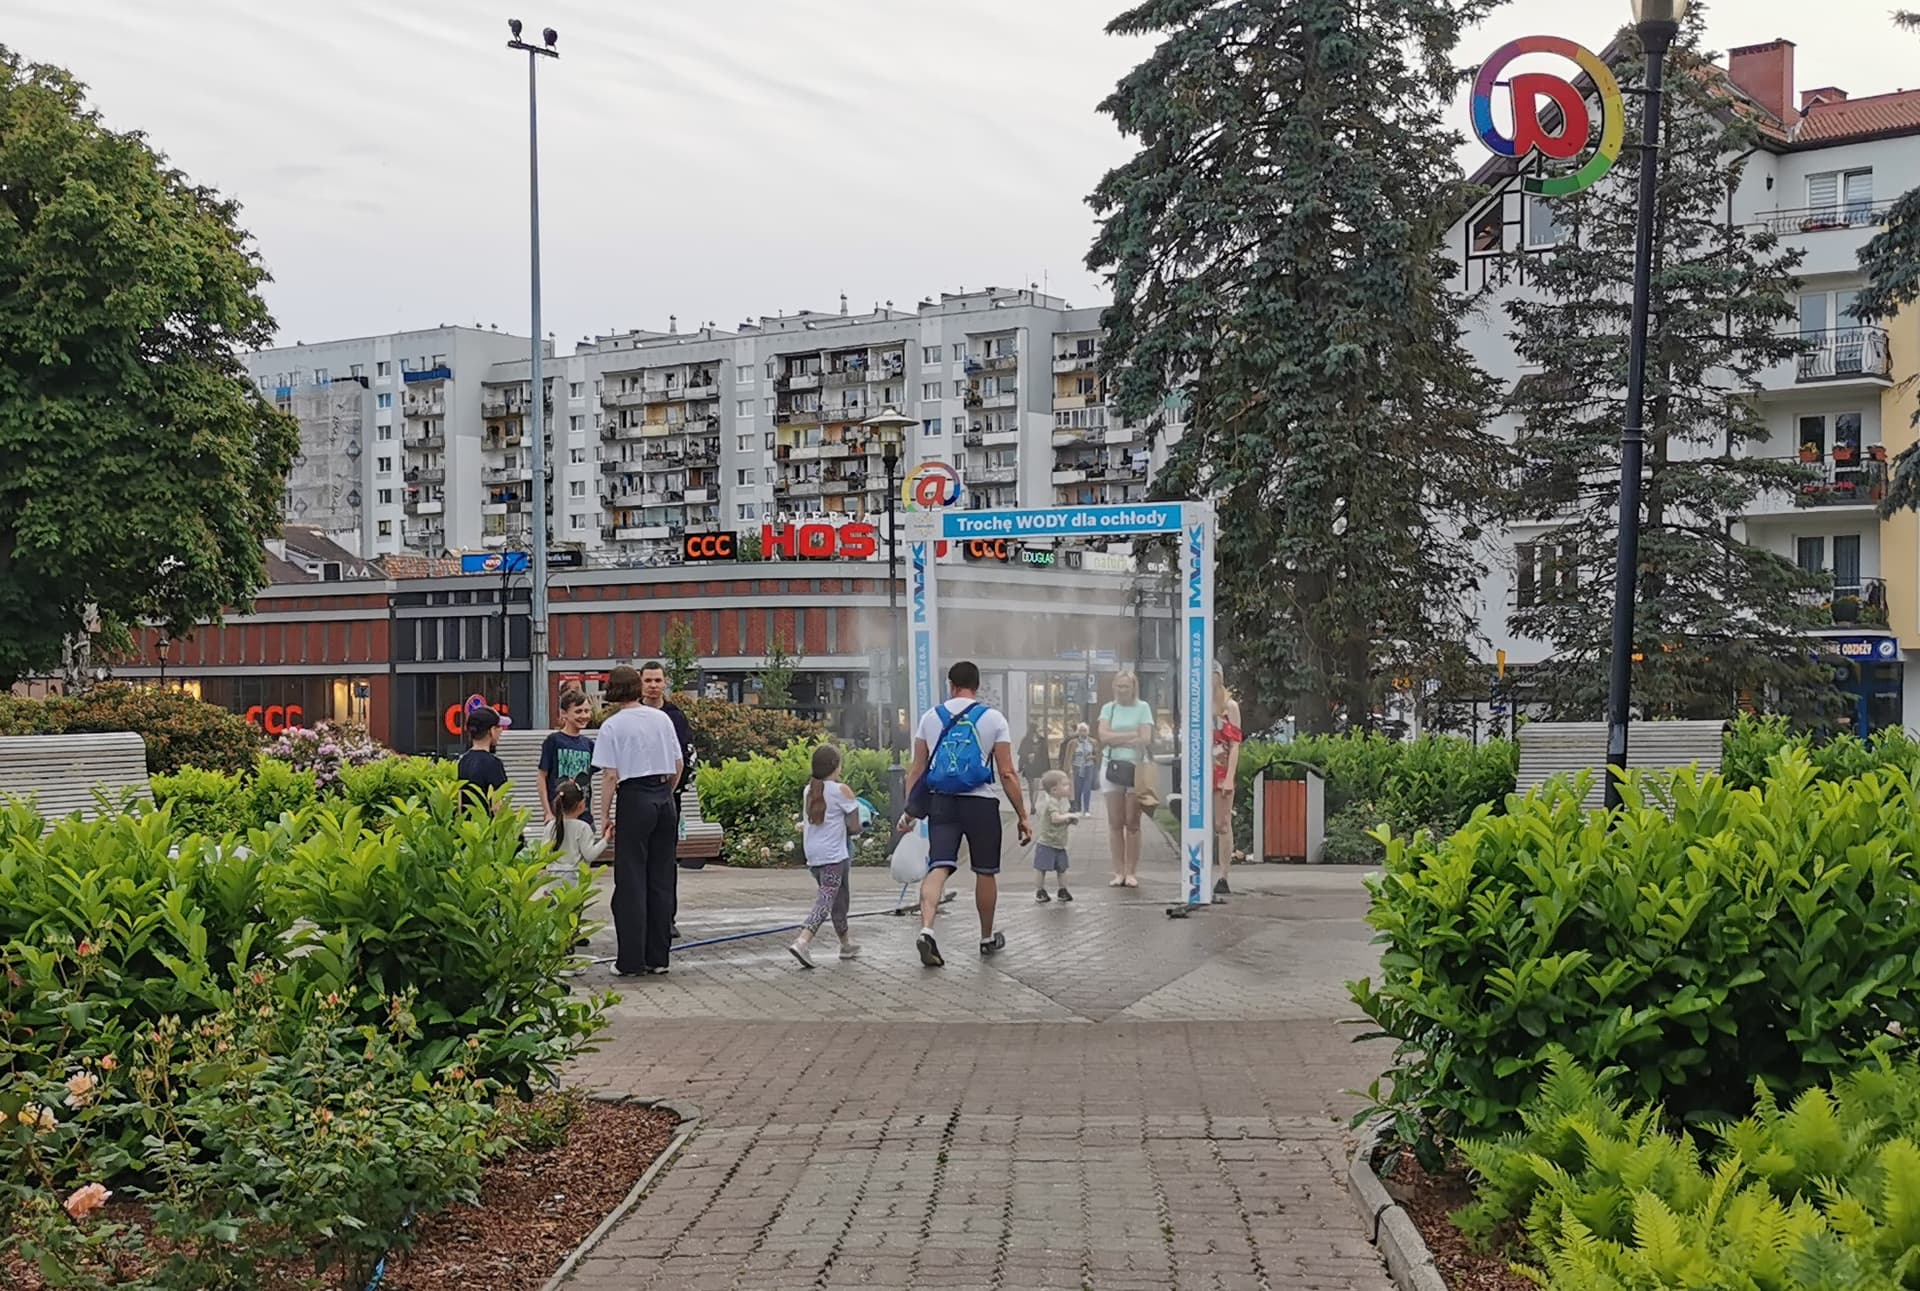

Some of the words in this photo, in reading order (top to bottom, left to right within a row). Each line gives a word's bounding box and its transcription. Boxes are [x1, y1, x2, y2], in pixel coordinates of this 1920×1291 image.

[762, 511, 872, 523] GALERIA
[957, 517, 1013, 534] Trochę
[1016, 514, 1068, 529] WODY
[1071, 512, 1097, 527] dla
[1100, 510, 1167, 528] ochłody
[687, 535, 731, 557] CCC
[970, 538, 1006, 559] CCC
[1021, 551, 1055, 564] DOUGLAS
[1189, 522, 1203, 608] MWK
[913, 541, 927, 624] MWK
[1190, 668, 1201, 723] KANALIZACJA
[246, 705, 304, 734] CCC
[1190, 729, 1202, 776] WODOCIĄGI
[1190, 777, 1201, 816] MIEJSKIE
[1188, 843, 1201, 904] WK
